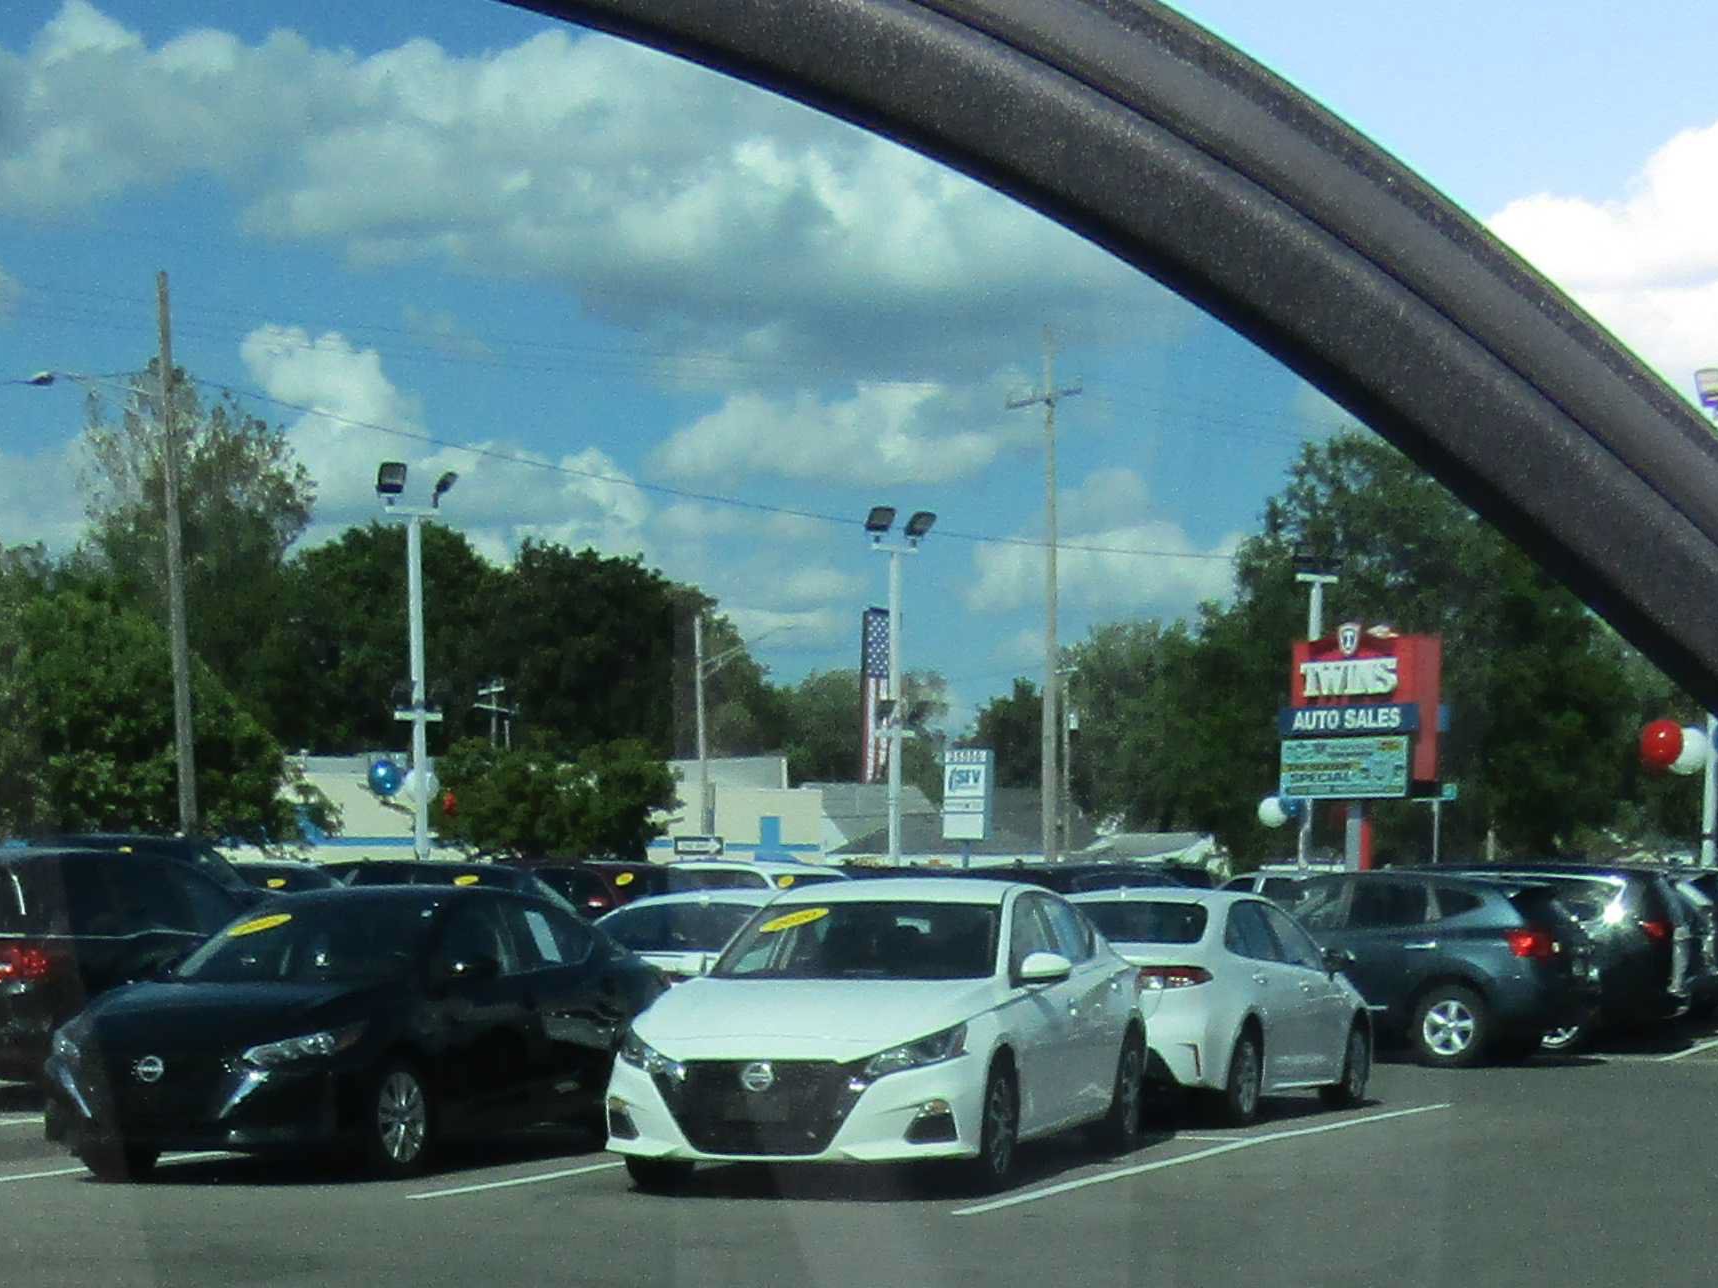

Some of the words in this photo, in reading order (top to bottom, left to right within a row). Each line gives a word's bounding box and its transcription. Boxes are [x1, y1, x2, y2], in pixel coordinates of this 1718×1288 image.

[1300, 657, 1399, 697] TWINS
[1292, 709, 1340, 731] AUTO
[1343, 706, 1402, 730] SALES
